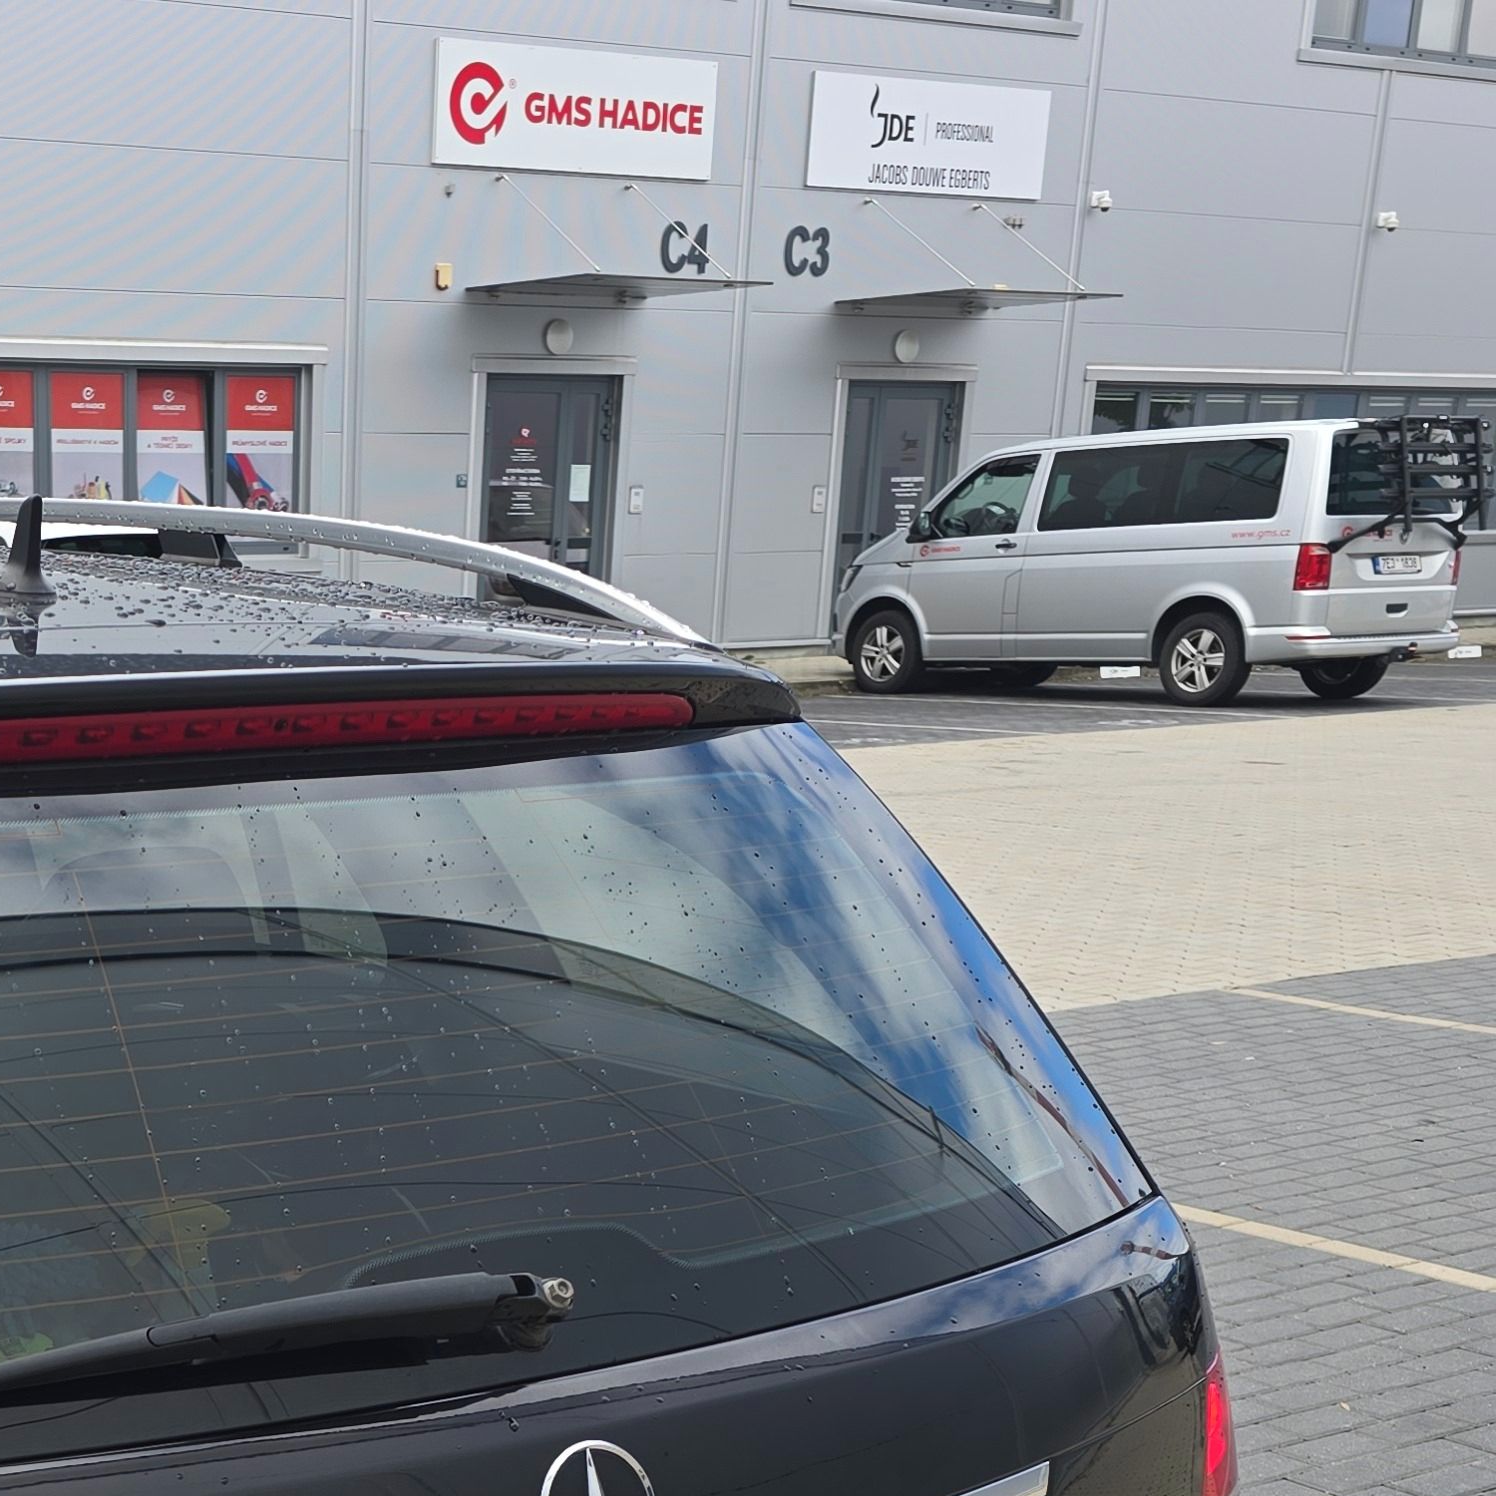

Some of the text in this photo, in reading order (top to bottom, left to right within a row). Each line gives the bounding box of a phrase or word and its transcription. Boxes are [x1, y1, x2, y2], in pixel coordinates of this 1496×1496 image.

[524, 91, 704, 135] GMS HADICE
[870, 112, 994, 148] JDE PROFESSIONAL
[867, 163, 991, 190] JACOBS DOUWE EGBERTS
[660, 220, 710, 275] C4
[784, 225, 830, 277] C3
[1231, 528, 1291, 540] www.gms.cz
